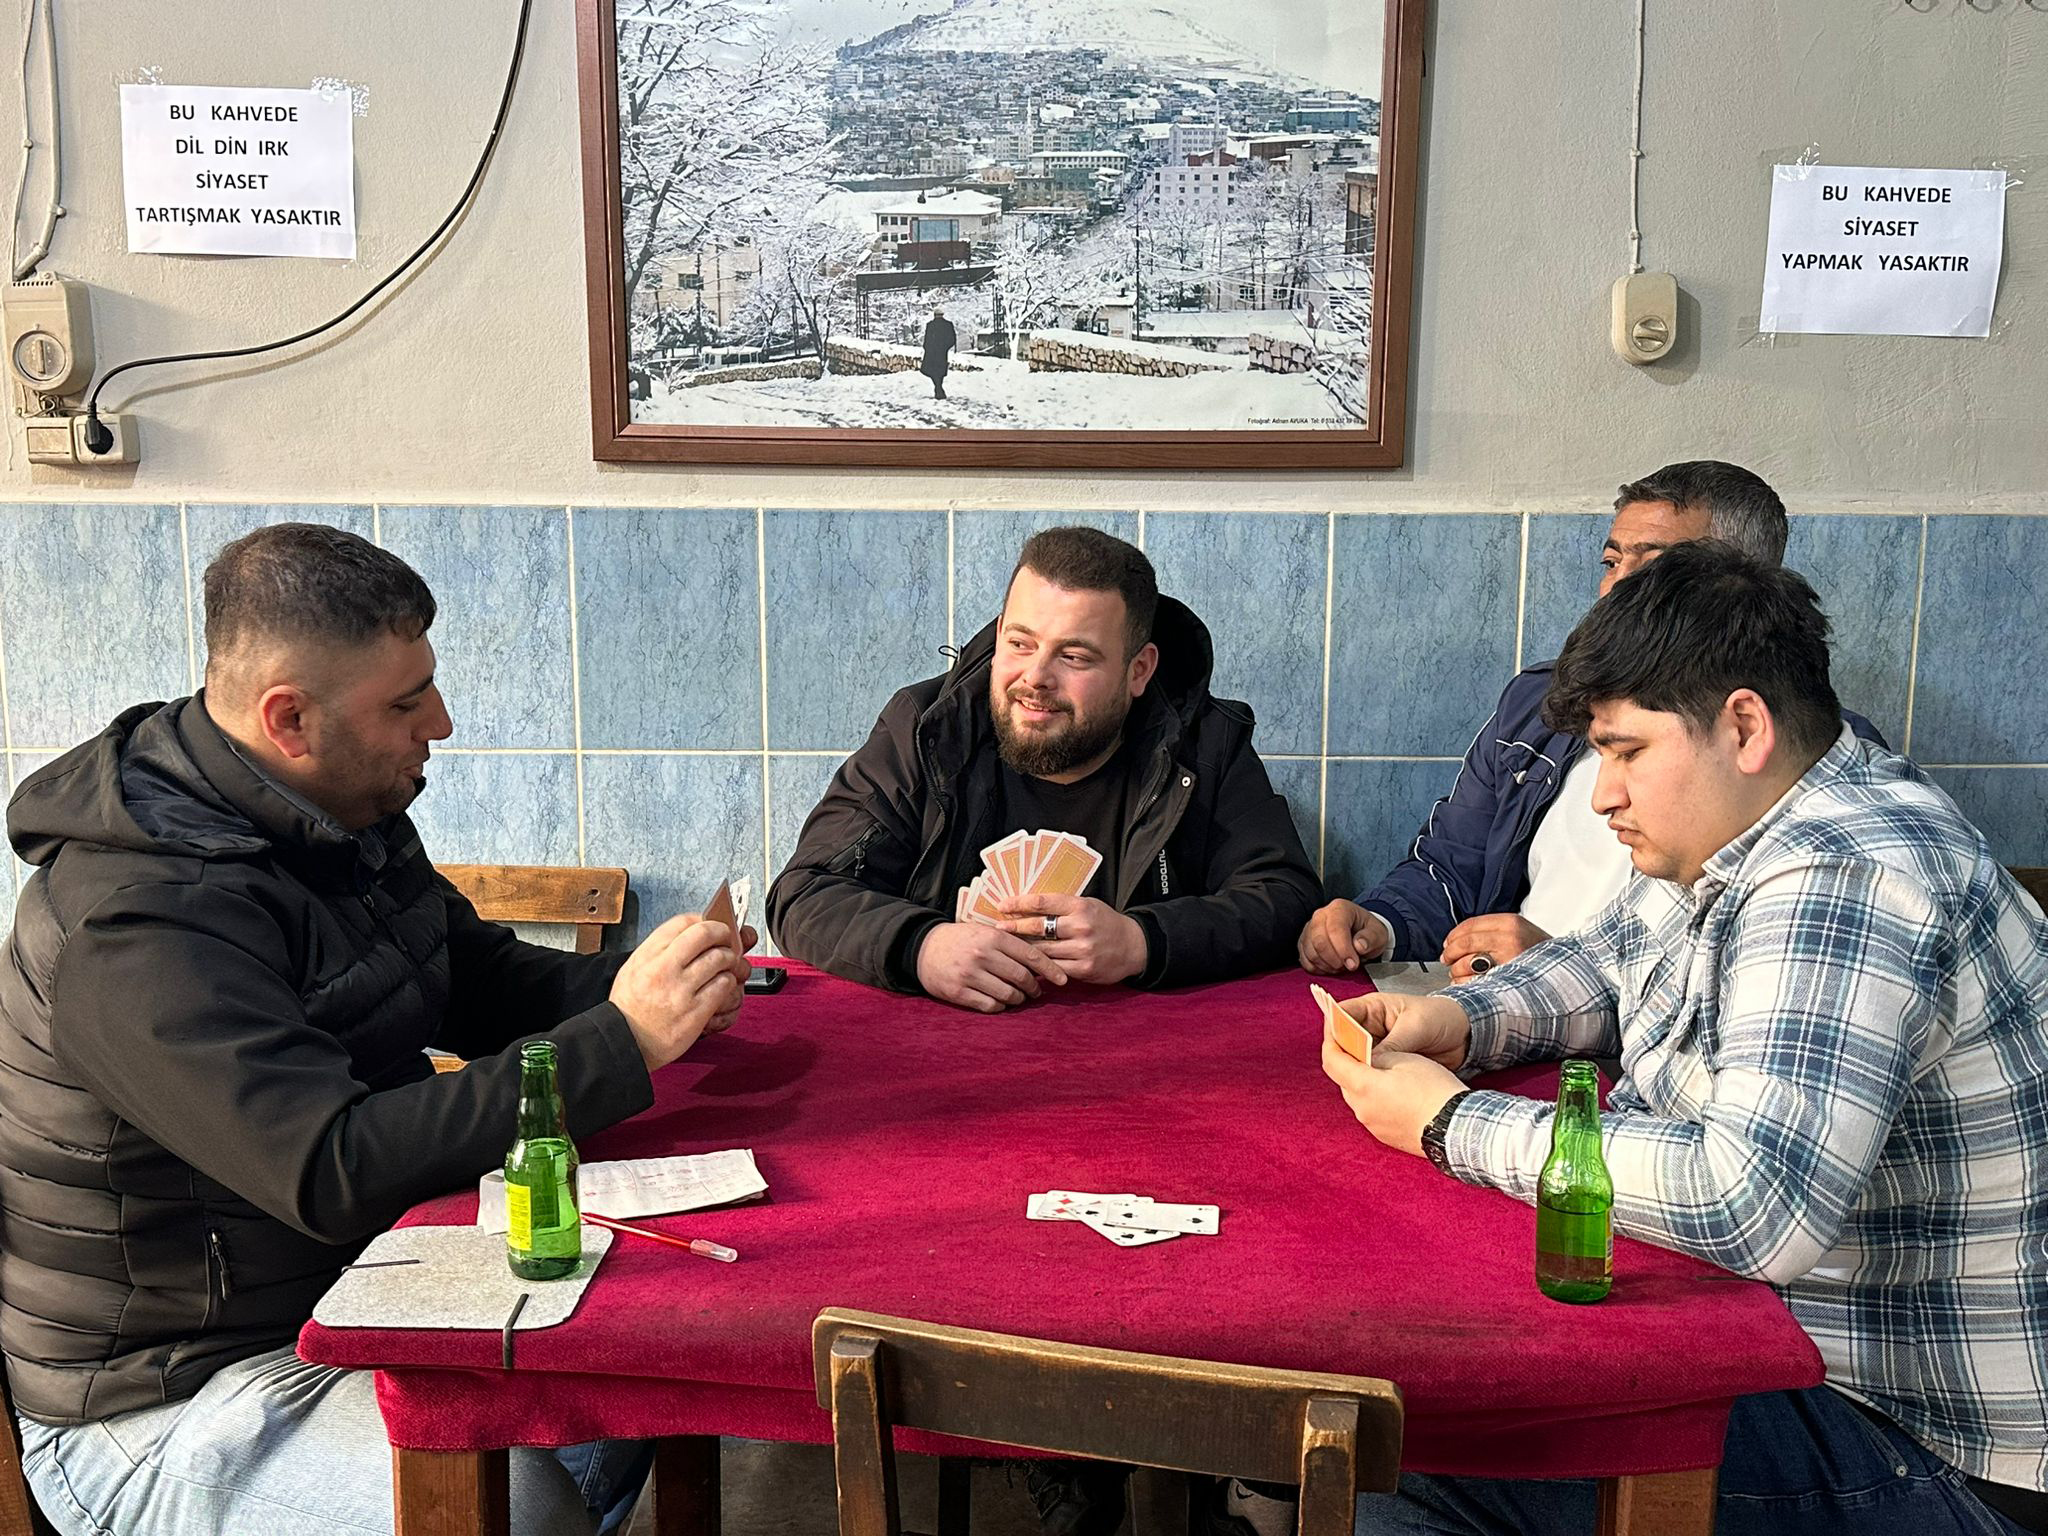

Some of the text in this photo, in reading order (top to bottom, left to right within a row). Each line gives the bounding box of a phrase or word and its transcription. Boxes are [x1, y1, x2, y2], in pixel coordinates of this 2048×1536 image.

[170, 104, 299, 123] BU KAHVEDE
[175, 135, 289, 157] DİL DİN IRK
[196, 169, 269, 190] SİYASET
[1822, 185, 1952, 204] BU KAHVEDE
[135, 207, 342, 227] TARTIŞMAK YASAKTIR
[1843, 216, 1920, 237] SİYASET
[1781, 253, 1970, 272] YAPMAK YASAKTIR
